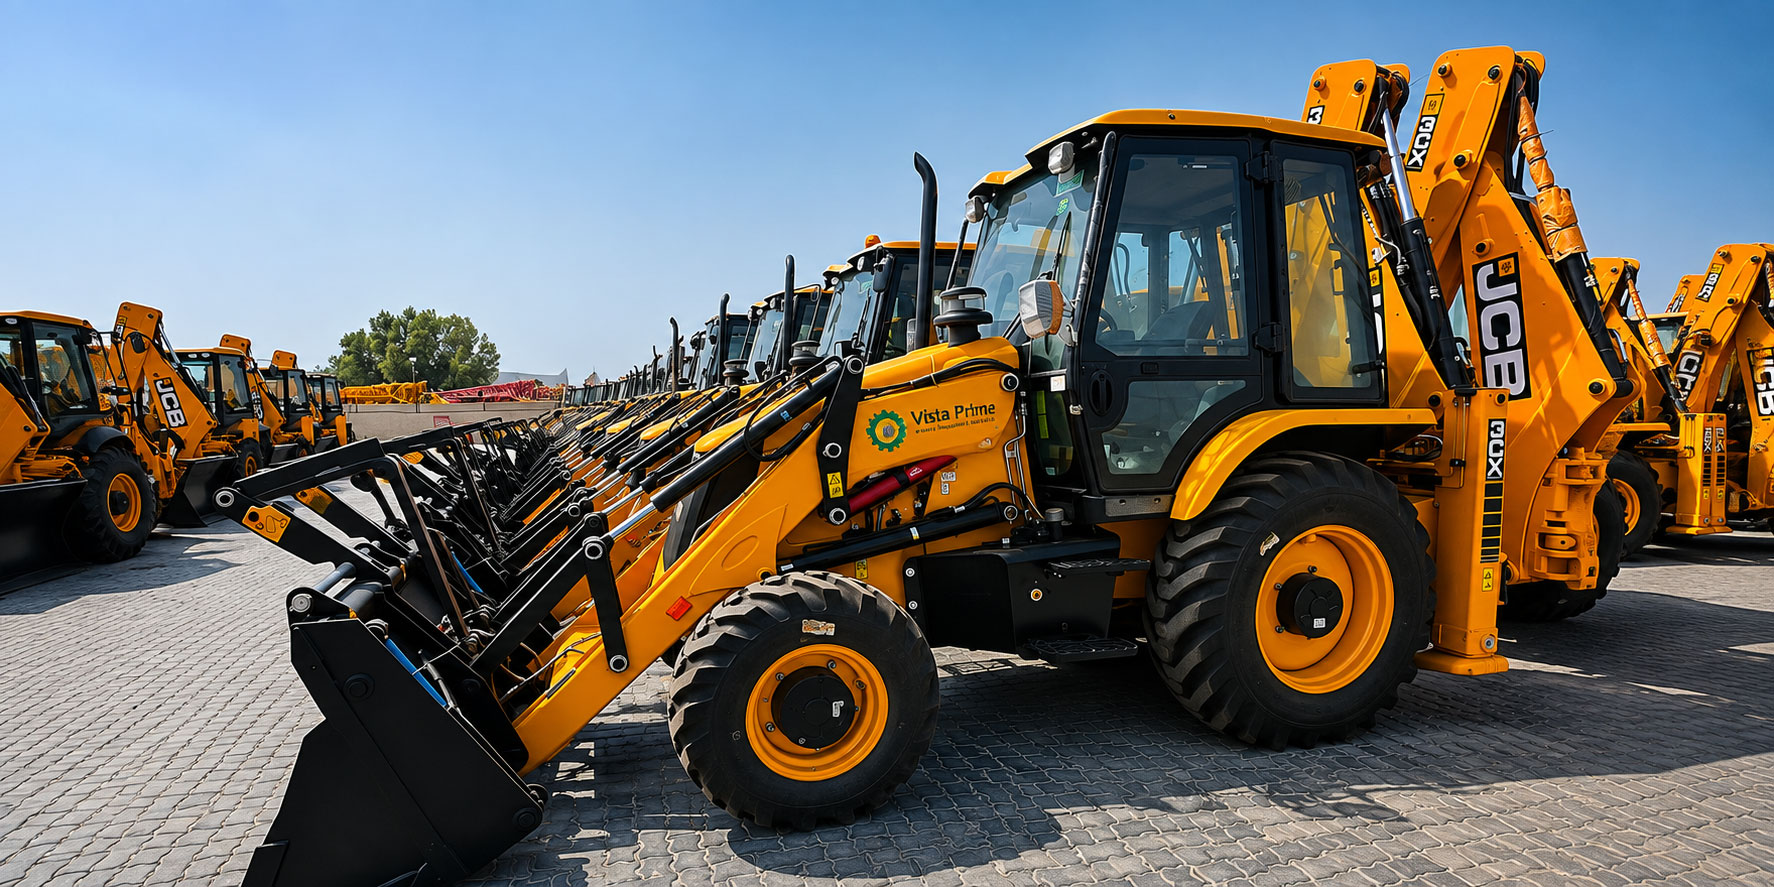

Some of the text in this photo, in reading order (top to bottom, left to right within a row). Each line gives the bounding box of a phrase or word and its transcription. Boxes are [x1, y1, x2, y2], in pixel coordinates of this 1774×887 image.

[1407, 116, 1437, 167] 3CX
[1476, 263, 1526, 396] JCB
[155, 378, 187, 429] JCB
[910, 408, 950, 426] Vista
[954, 403, 996, 419] Prime
[1487, 420, 1505, 477] 3CX
